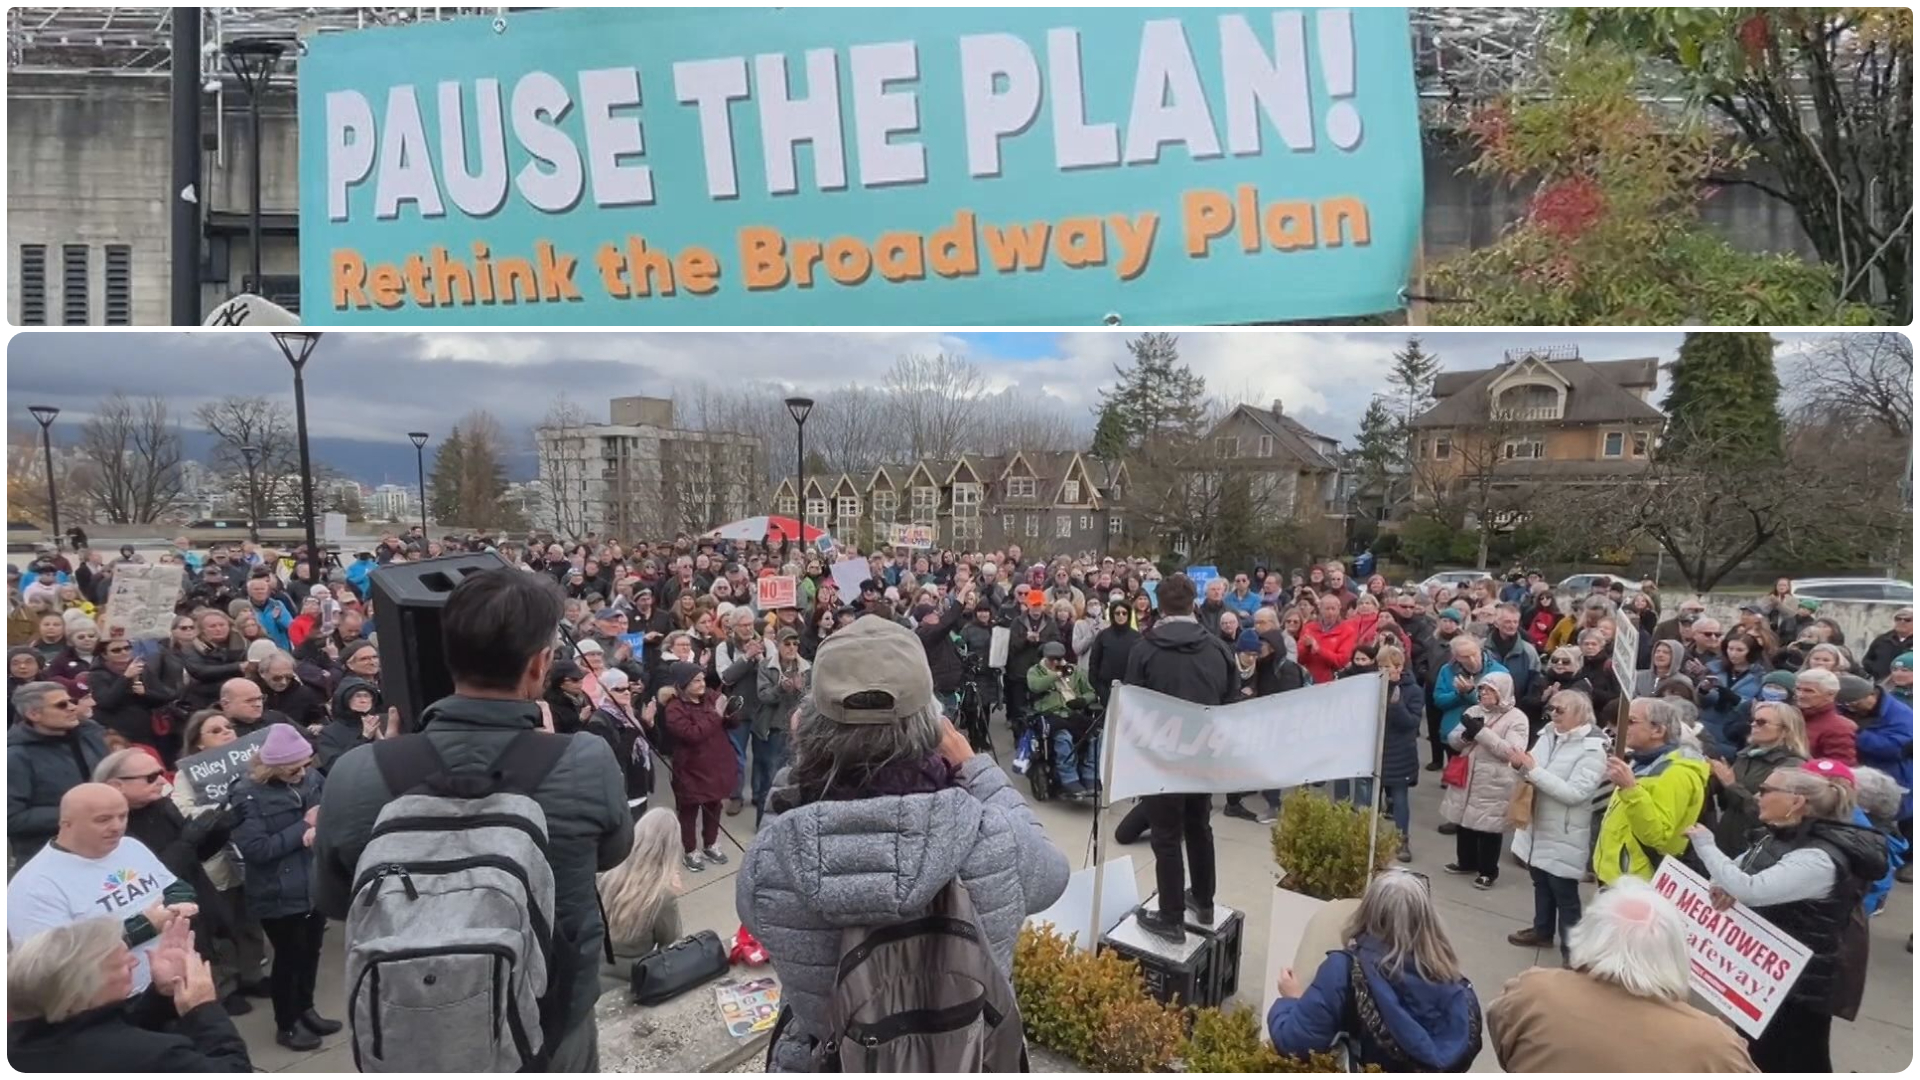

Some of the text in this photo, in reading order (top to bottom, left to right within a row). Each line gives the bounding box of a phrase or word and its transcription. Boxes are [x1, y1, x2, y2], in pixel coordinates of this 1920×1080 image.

[325, 8, 1363, 223] PAUSE THE PLAN!
[331, 181, 1370, 310] Rethink the Broadway Plan
[760, 581, 777, 598] NO
[189, 743, 260, 782] Riley Park
[95, 872, 159, 912] TEAM
[1655, 872, 1678, 900] NO
[1676, 888, 1791, 982] MEGATOWERS
[1684, 922, 1776, 1003] afeway!
